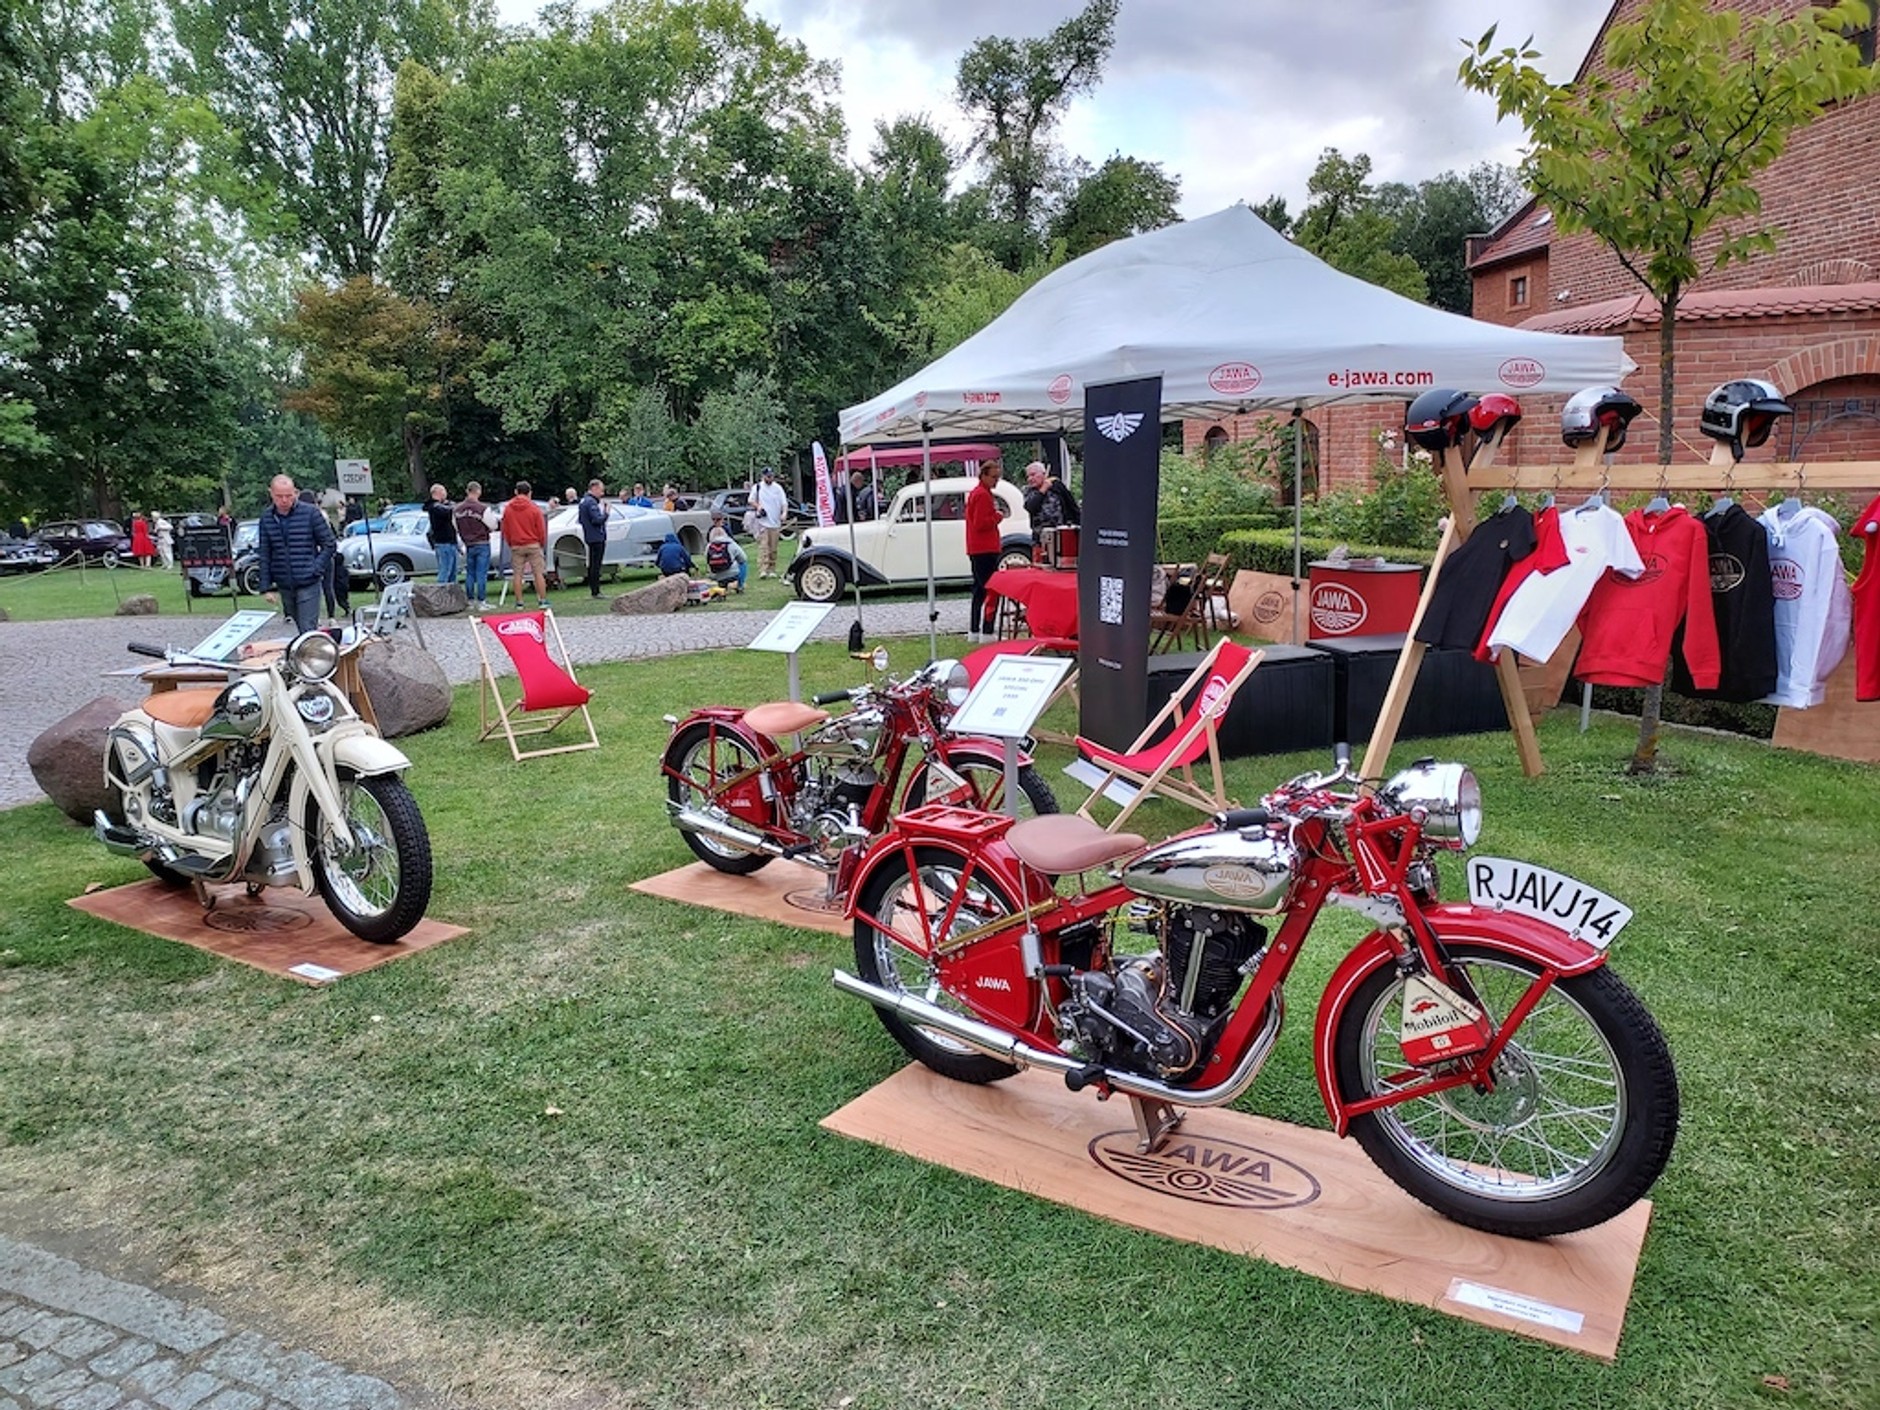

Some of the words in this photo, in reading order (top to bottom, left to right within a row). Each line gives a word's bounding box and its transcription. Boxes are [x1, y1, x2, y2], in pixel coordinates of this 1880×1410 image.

[1219, 367, 1251, 379] JAWA
[1507, 363, 1536, 373] JAWA
[1327, 369, 1434, 388] e-jawa.com
[1771, 564, 1797, 580] AWA
[1317, 590, 1352, 611] JAWA
[1216, 869, 1254, 884] JAWA
[975, 975, 1012, 992] JAWA
[1404, 1009, 1460, 1034] Mobiloil
[1150, 1138, 1272, 1183] JAWA
